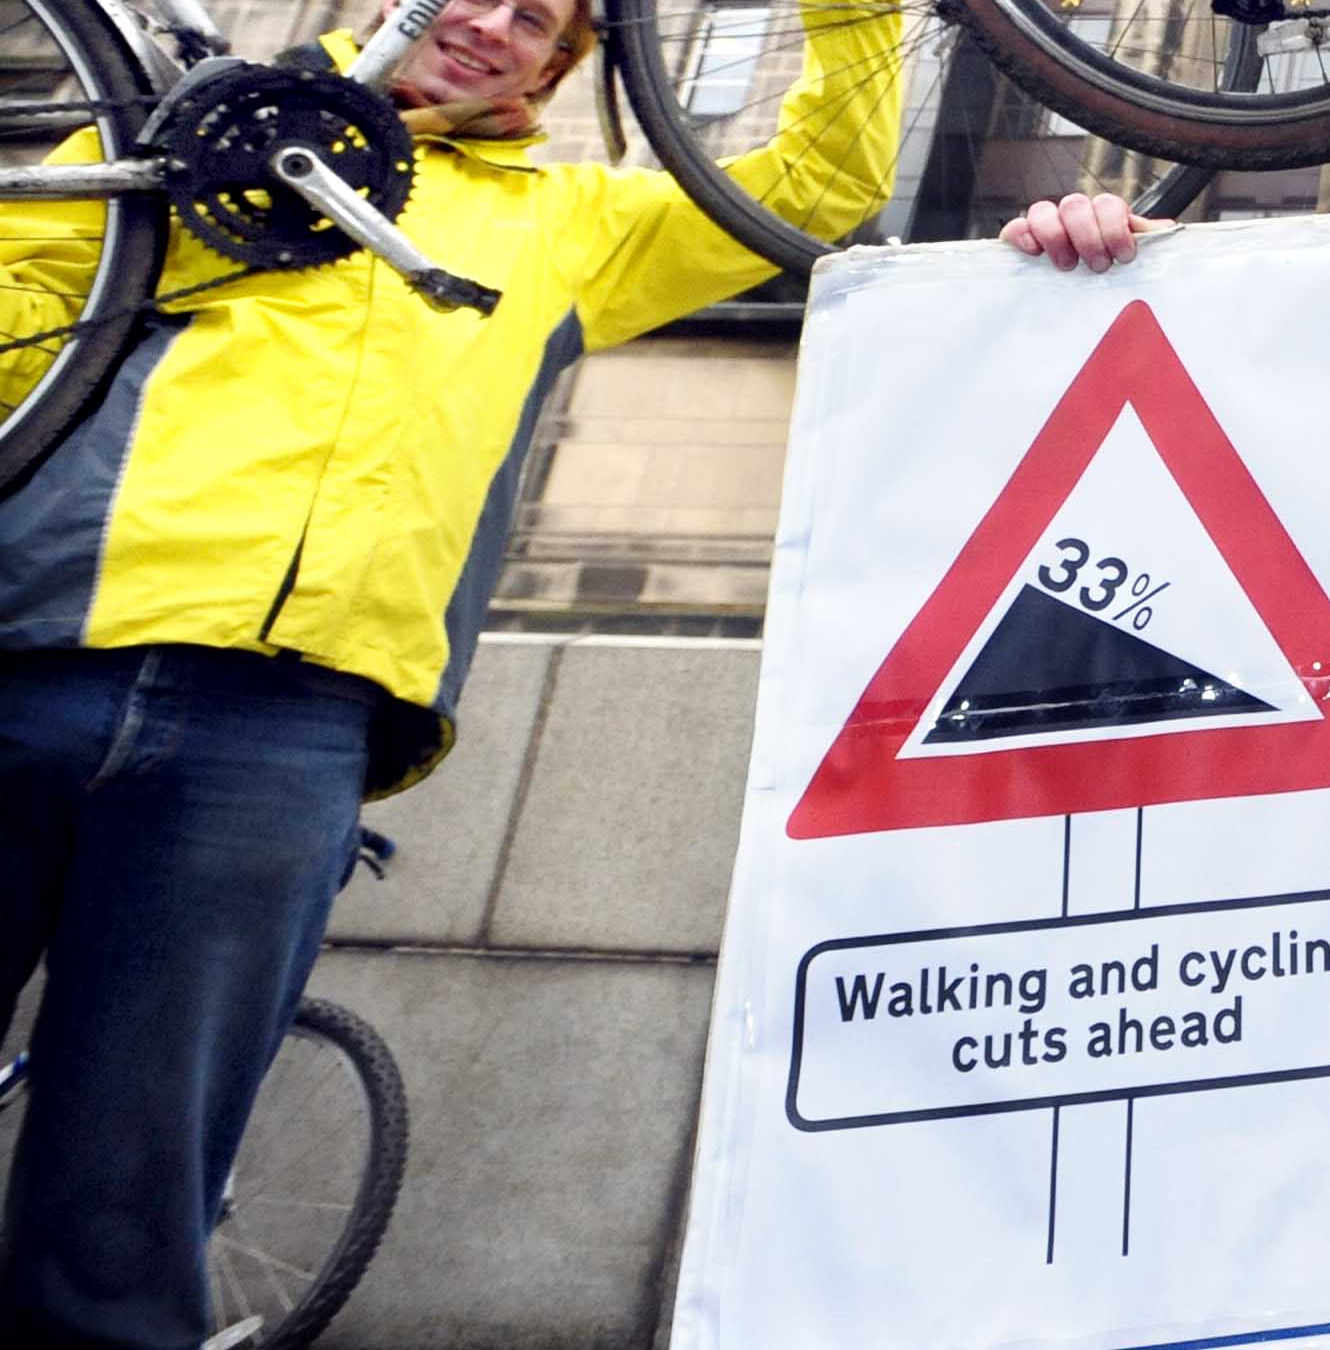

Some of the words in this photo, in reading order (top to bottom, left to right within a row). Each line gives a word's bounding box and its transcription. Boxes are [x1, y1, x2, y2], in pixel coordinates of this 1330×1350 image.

[1038, 537, 1171, 631] 33%
[834, 965, 1048, 1024] Walking
[1068, 943, 1160, 1000] and
[951, 1017, 1068, 1073] cuts
[1086, 995, 1243, 1059] ahead
